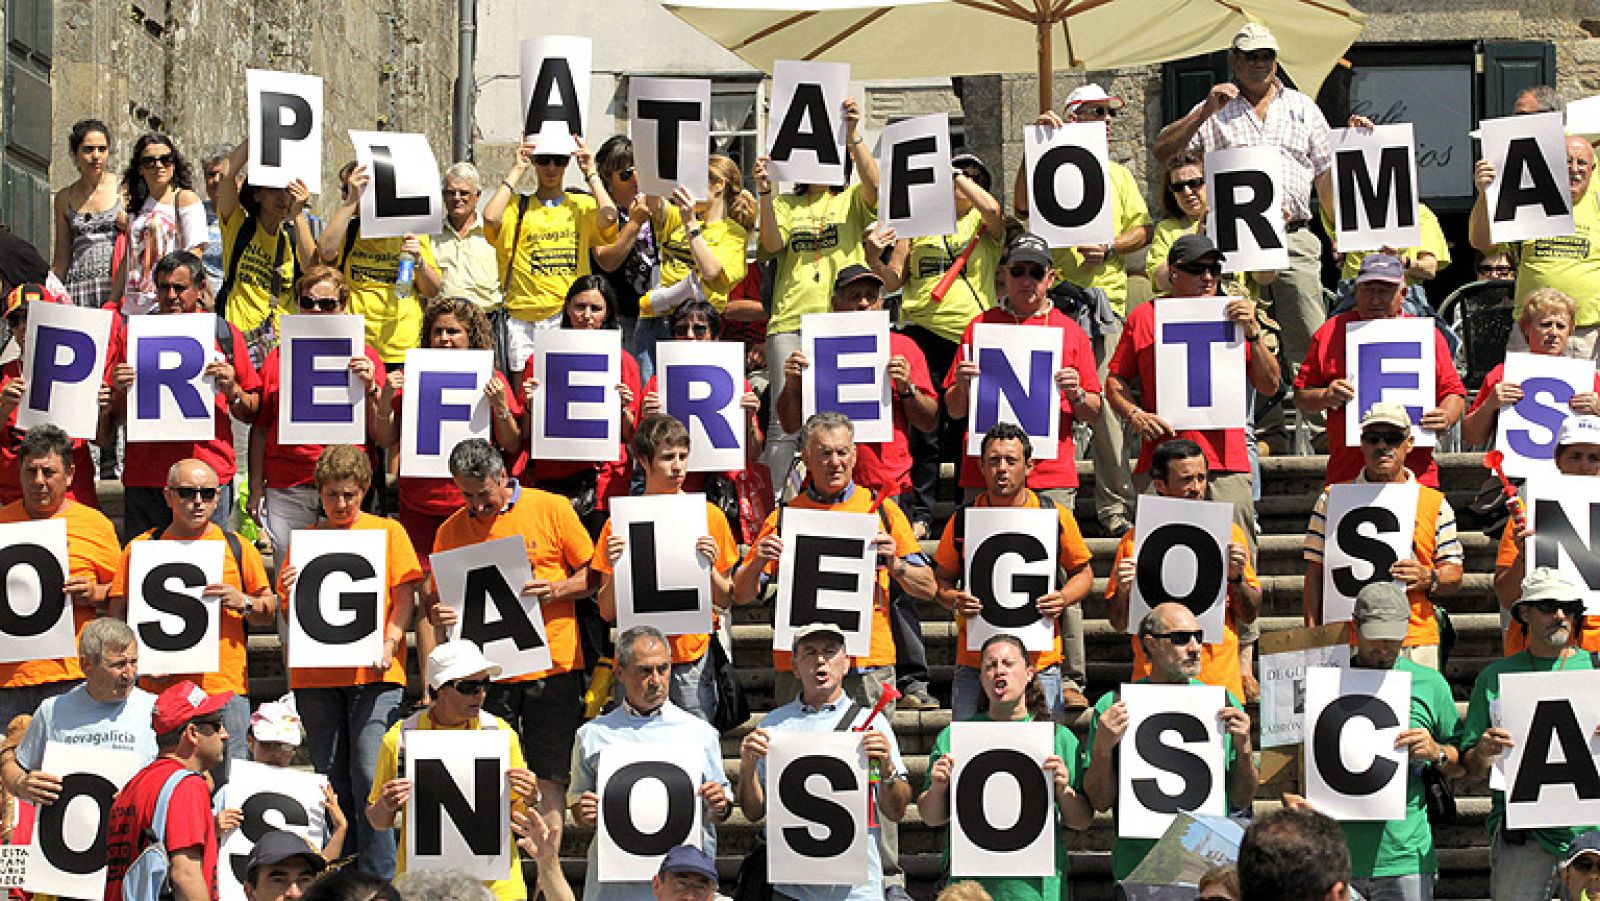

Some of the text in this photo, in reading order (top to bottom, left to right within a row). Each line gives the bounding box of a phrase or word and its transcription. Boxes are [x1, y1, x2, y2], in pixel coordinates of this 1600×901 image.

[260, 91, 313, 168] P
[523, 58, 582, 138] A
[637, 100, 702, 181] T
[769, 83, 840, 165] A
[369, 145, 431, 218] L
[889, 136, 937, 219] F
[1033, 145, 1104, 228] O
[1213, 170, 1283, 252] R
[1336, 146, 1415, 231] M
[1494, 137, 1568, 222] A
[29, 326, 97, 412] P
[137, 336, 210, 420] R
[291, 338, 353, 423] E
[544, 353, 608, 438] E
[666, 365, 740, 449] R
[814, 336, 880, 420] E
[975, 348, 1053, 436] N
[1162, 321, 1236, 408] T
[1358, 342, 1424, 425] E
[416, 371, 478, 456] F
[1506, 377, 1576, 460] S
[628, 521, 699, 613] L
[789, 534, 864, 632] E
[969, 532, 1050, 628] G
[1135, 523, 1223, 618] O
[1331, 506, 1400, 597] S
[1535, 499, 1600, 590] N
[0, 543, 65, 636] O
[137, 562, 210, 652] S
[295, 553, 377, 645] G
[460, 564, 544, 653] A
[1131, 712, 1213, 814] S
[1313, 693, 1401, 796] C
[1508, 699, 1600, 803] A
[39, 771, 119, 874] O
[414, 758, 501, 856] N
[602, 760, 695, 856] O
[778, 754, 859, 858] S
[955, 748, 1048, 853] O
